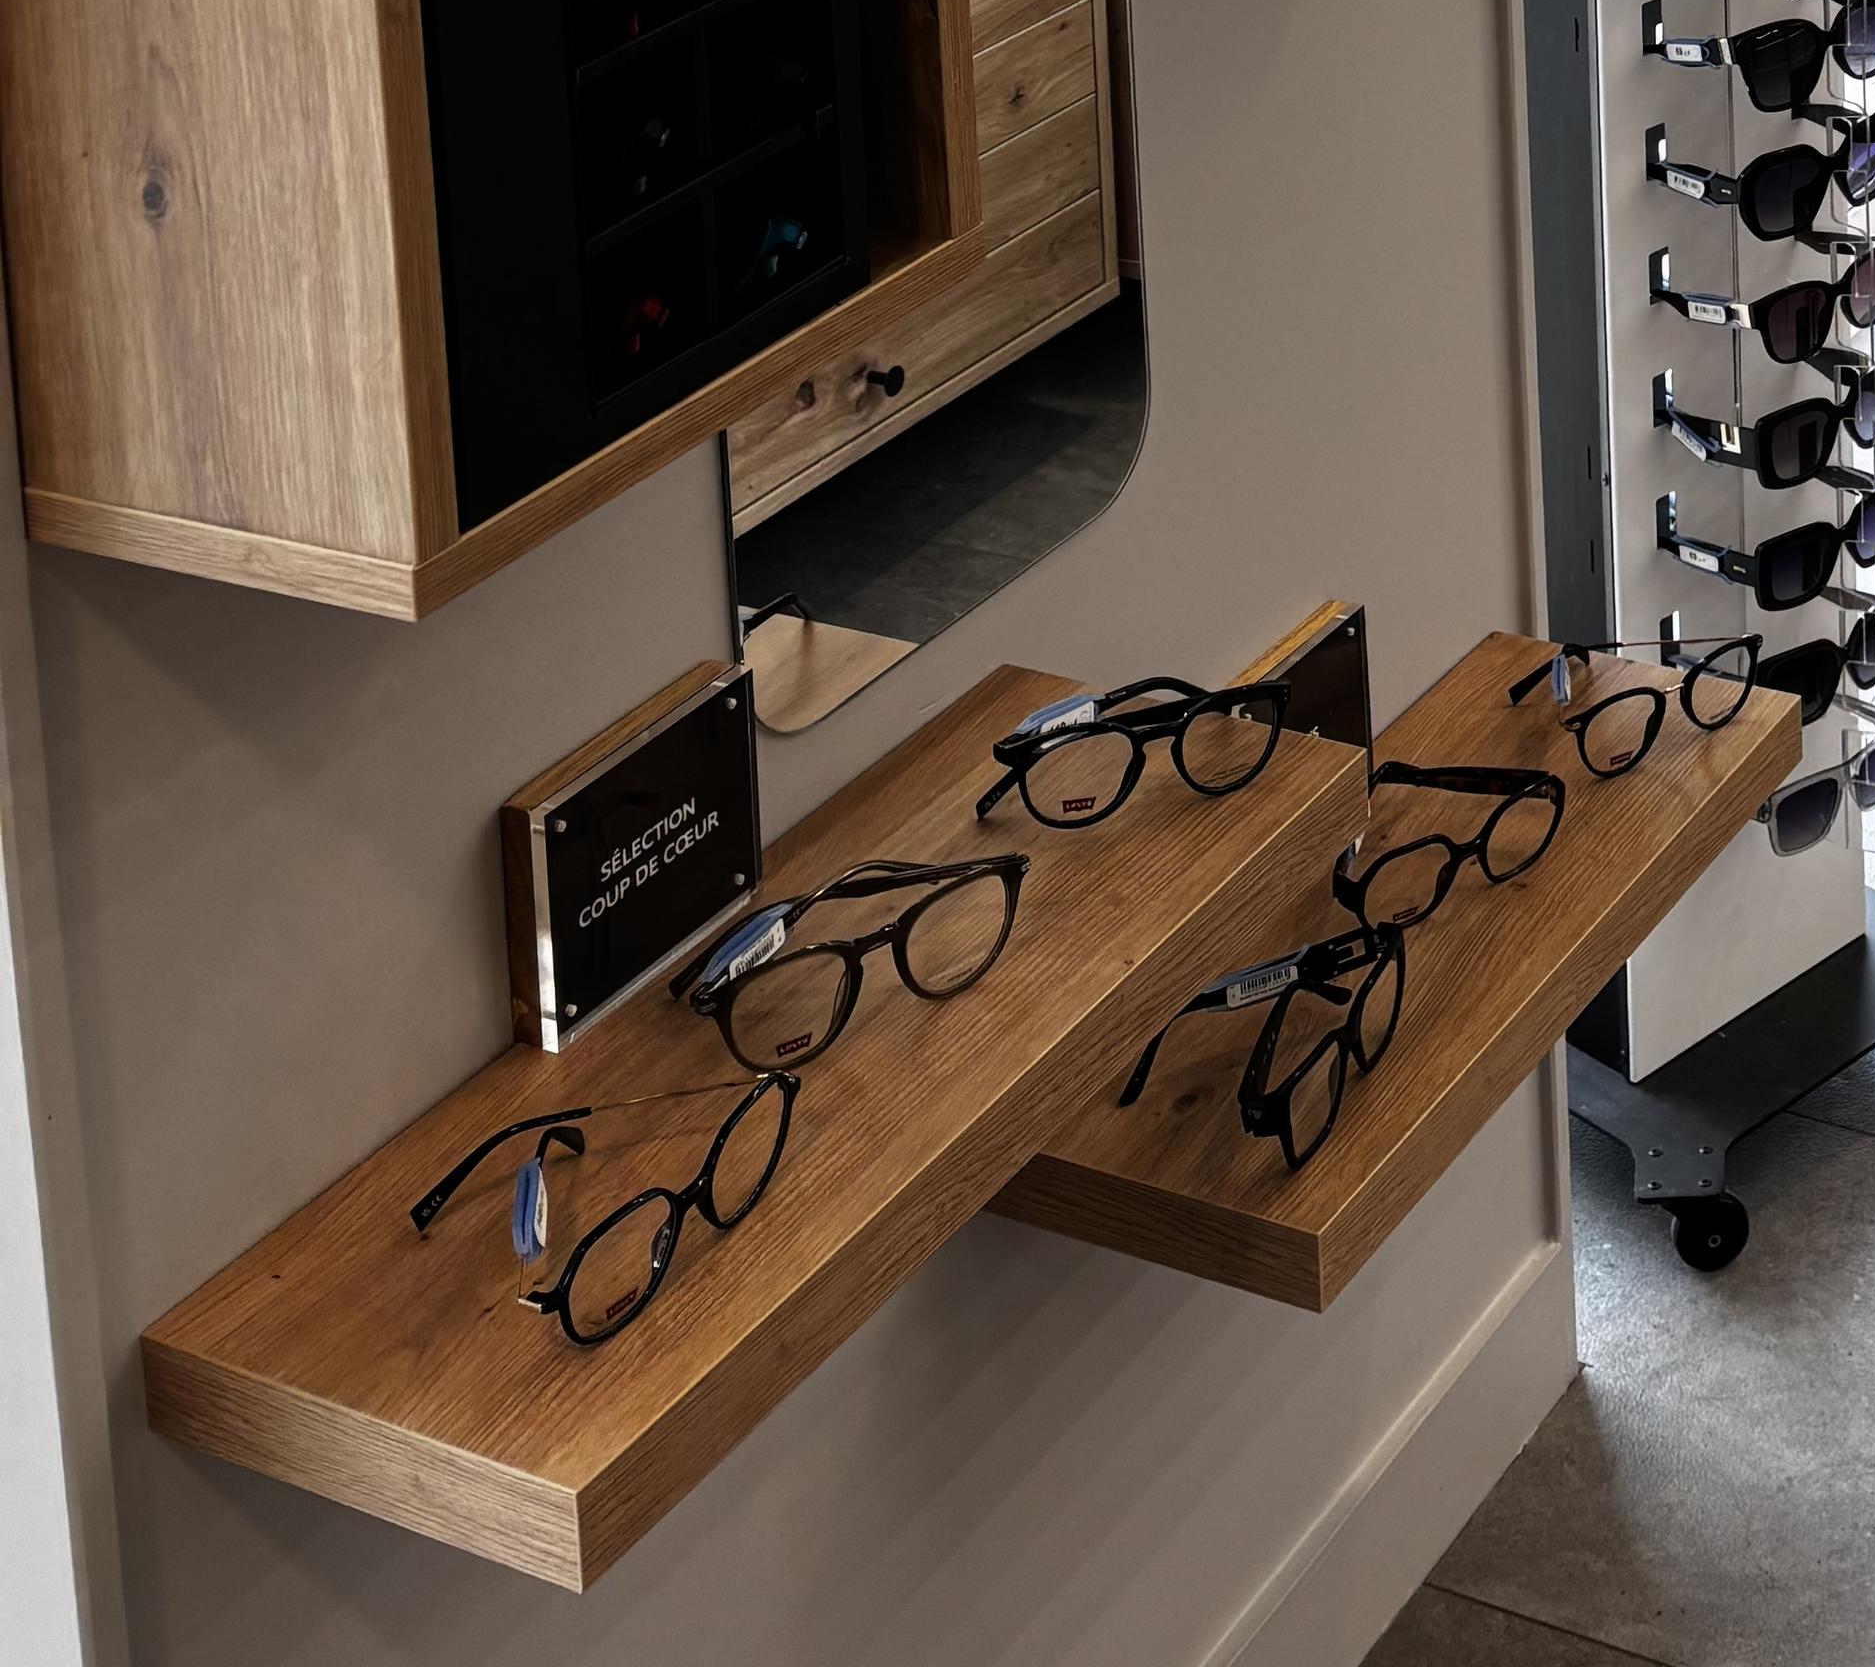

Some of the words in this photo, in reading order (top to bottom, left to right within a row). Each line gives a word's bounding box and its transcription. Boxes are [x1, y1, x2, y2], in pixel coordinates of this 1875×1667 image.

[578, 875, 631, 929] COUP
[634, 854, 660, 888] DE
[662, 810, 720, 863] CŒUR
[599, 796, 697, 883] SÉLECTION
